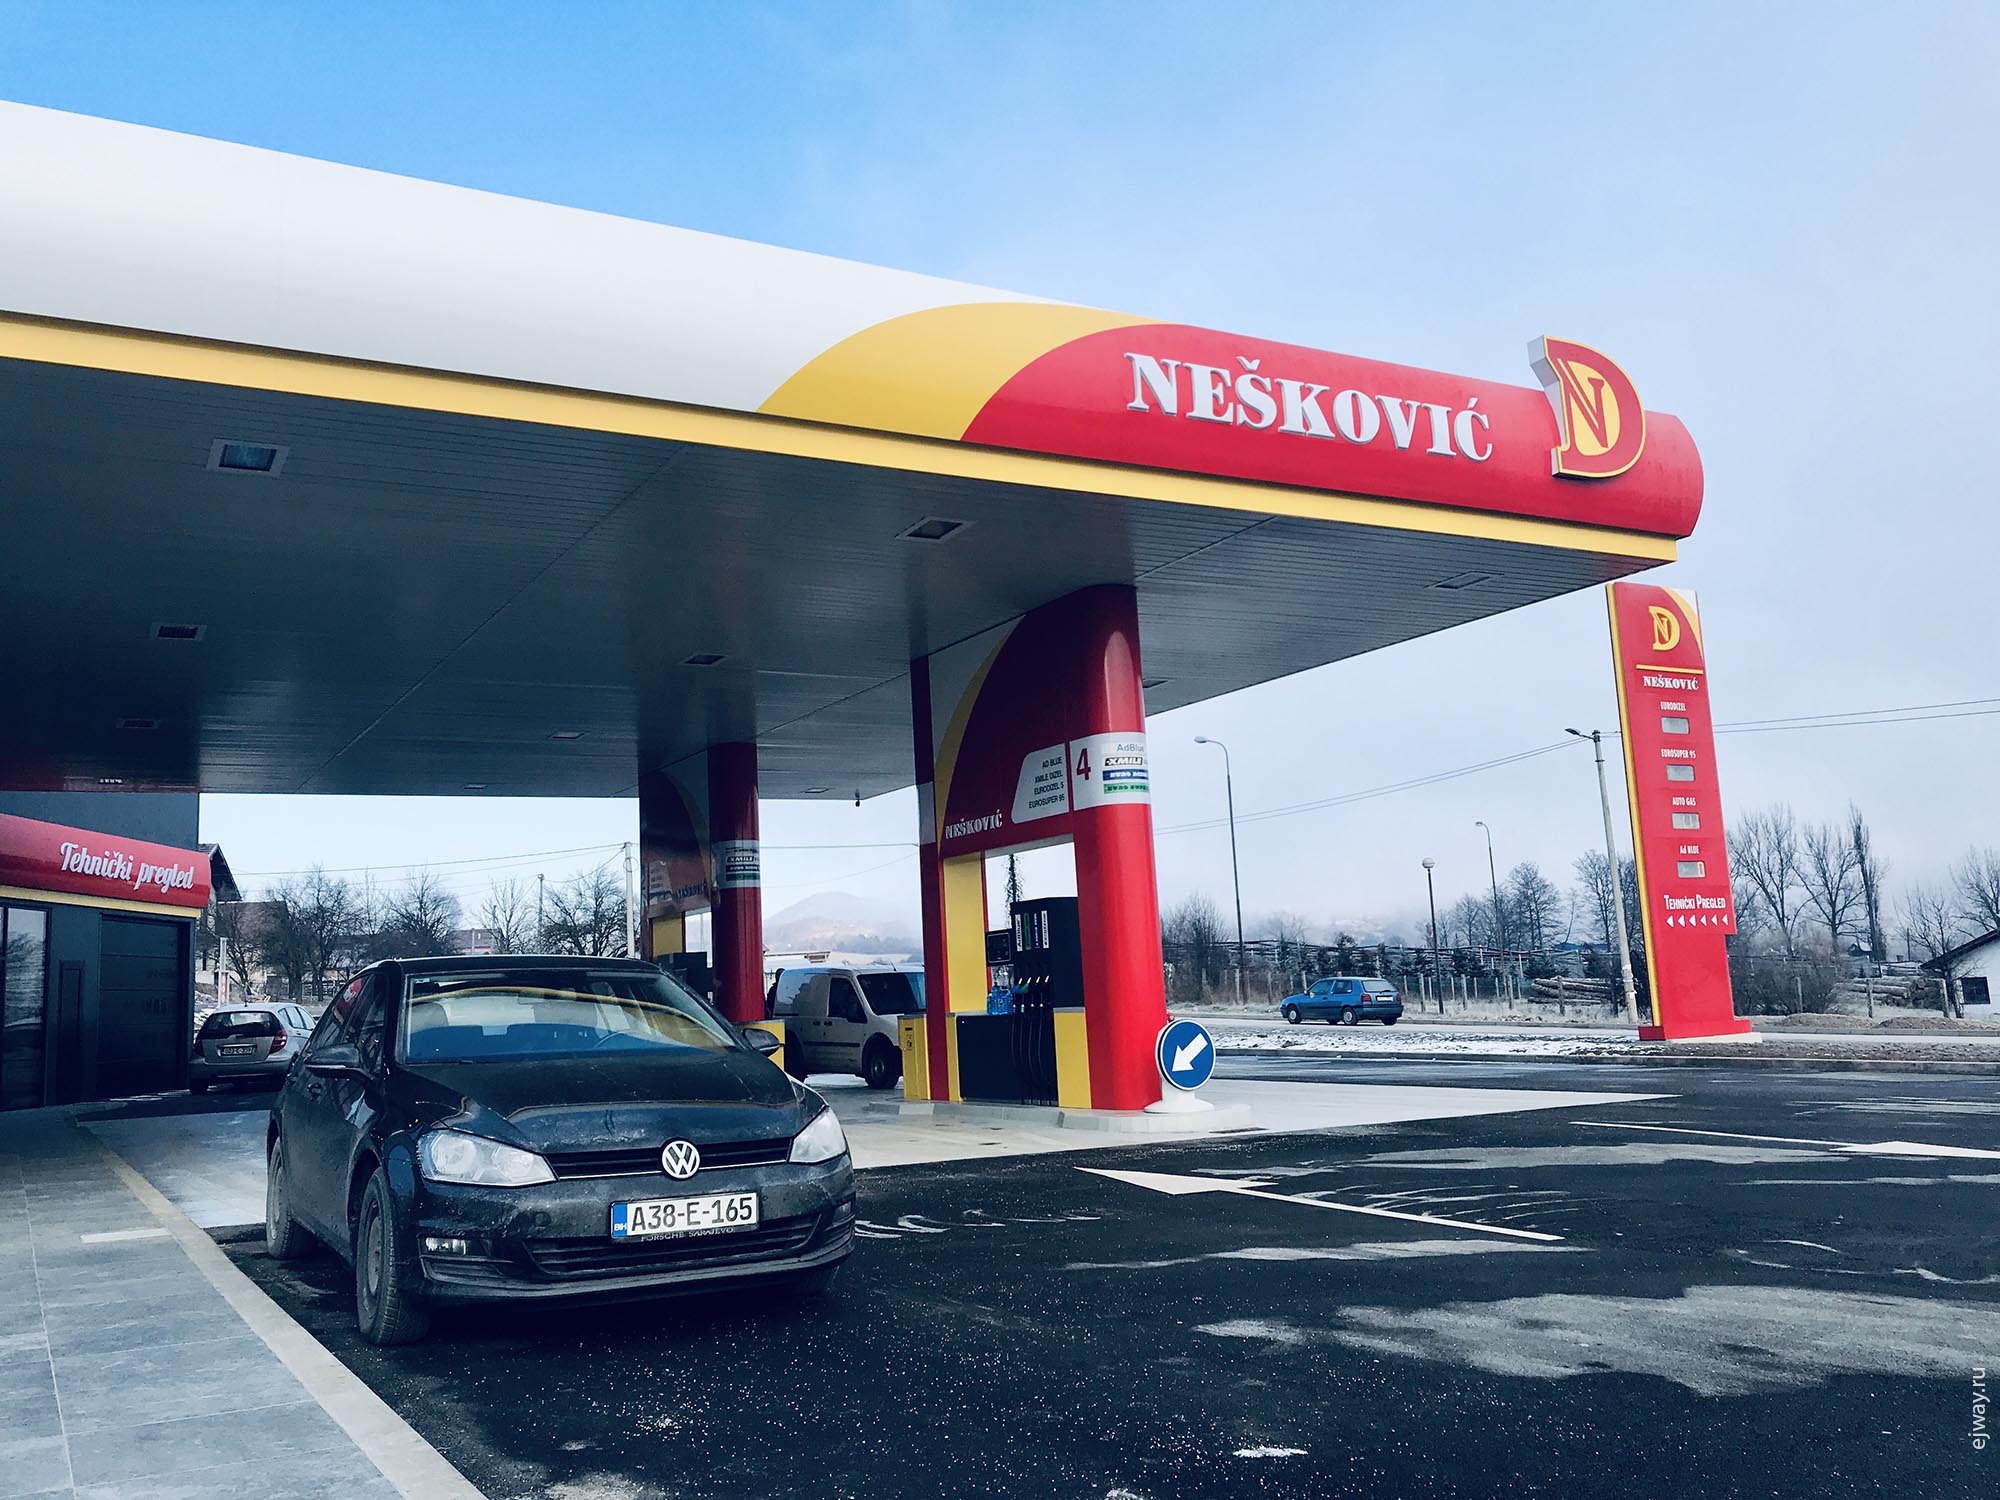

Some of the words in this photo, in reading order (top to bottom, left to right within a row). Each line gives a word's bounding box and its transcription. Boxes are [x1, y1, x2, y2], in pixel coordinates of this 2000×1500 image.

[1123, 352, 1494, 462] NEŠKOVIĆ
[1643, 674, 1699, 690] NEŠKOVIĆ
[1076, 747, 1092, 780] 4
[1029, 794, 1058, 809] EUROSUPER
[945, 808, 1003, 840] NEŠKOVIĆ
[60, 842, 134, 881] Tehnički
[134, 862, 194, 893] pregled
[614, 1223, 627, 1232] BIH
[631, 1197, 752, 1232] A38-E-165
[641, 1232, 685, 1242] PORSCHE
